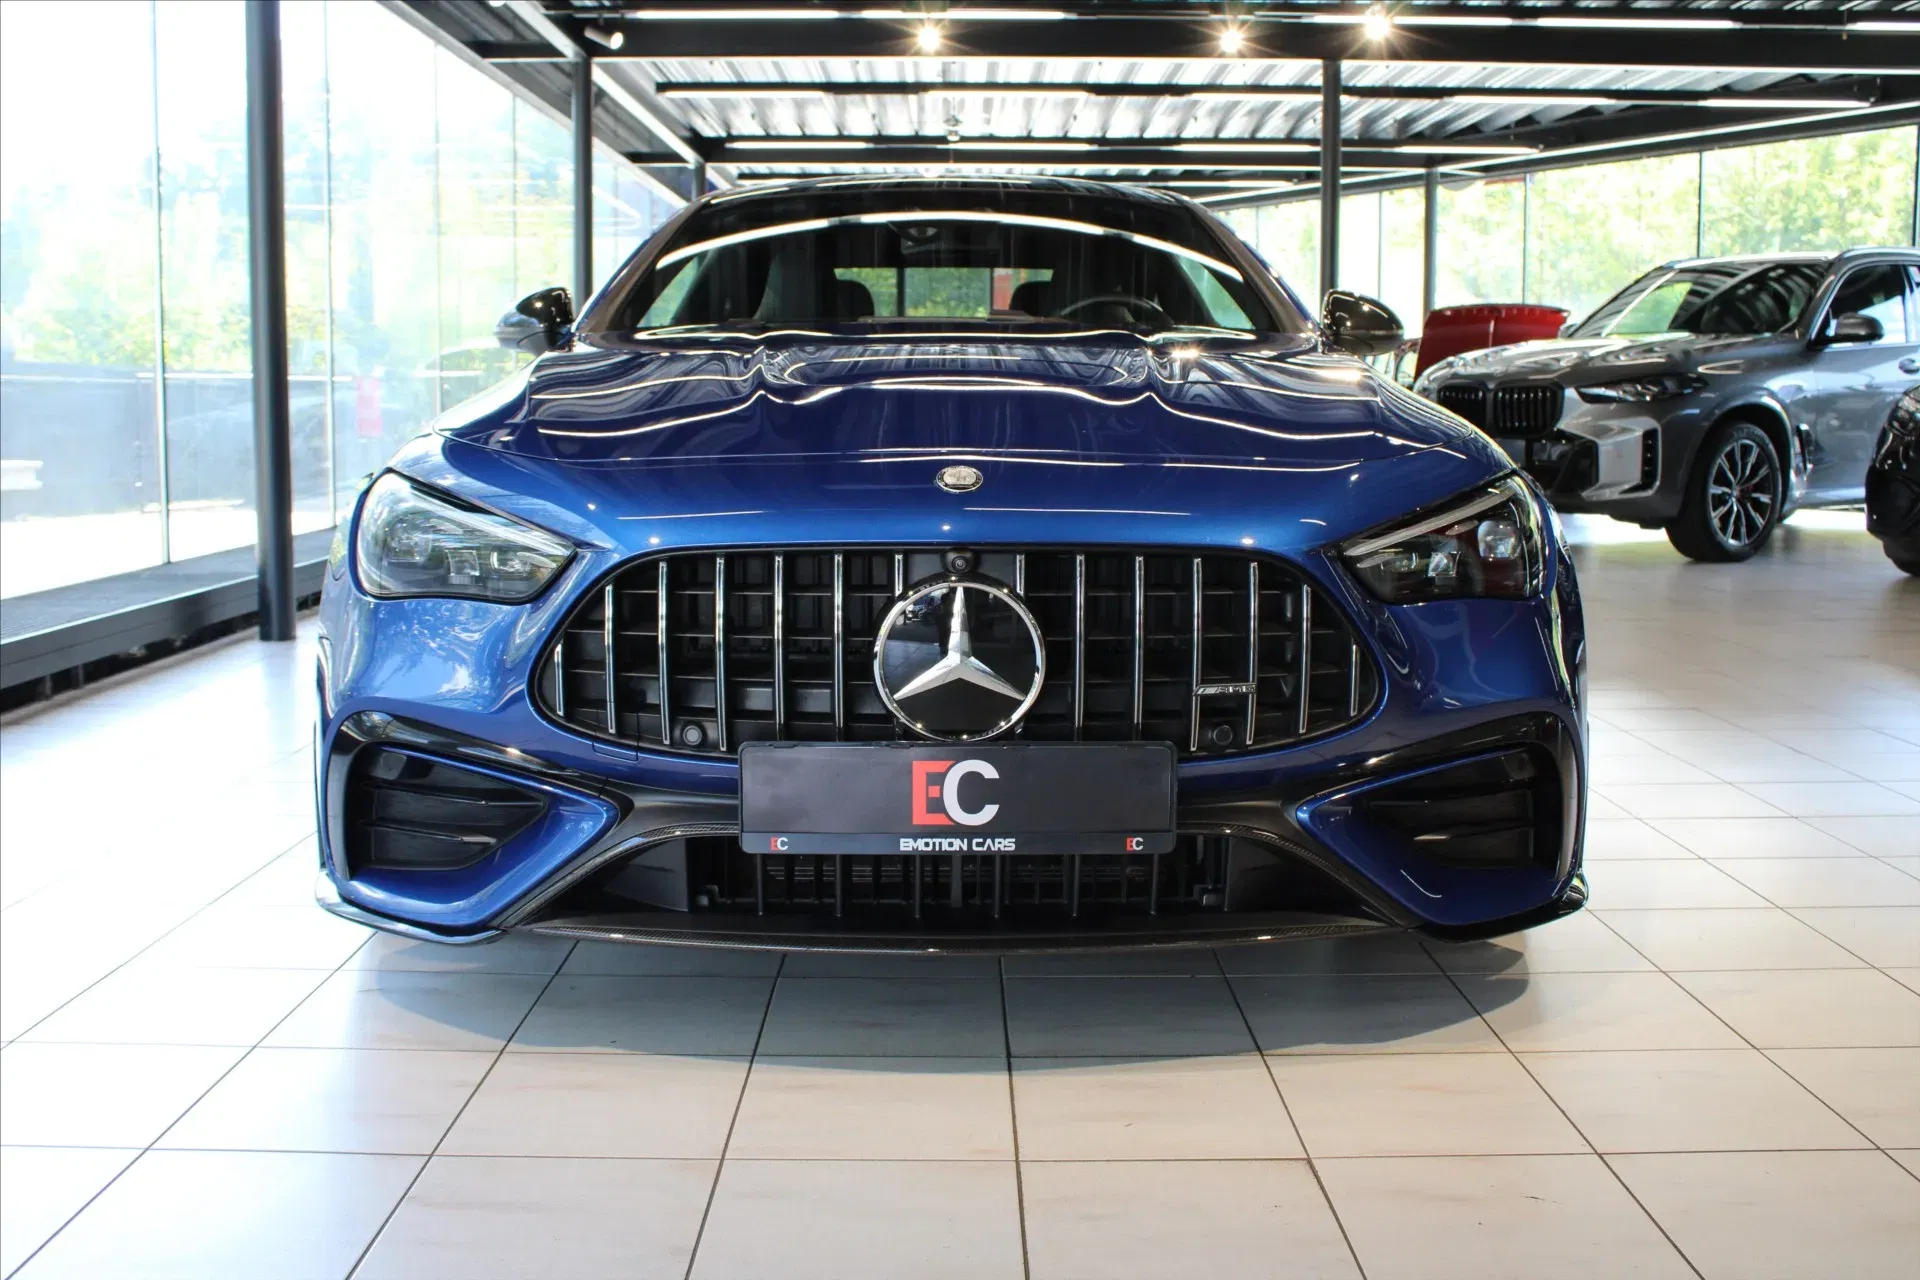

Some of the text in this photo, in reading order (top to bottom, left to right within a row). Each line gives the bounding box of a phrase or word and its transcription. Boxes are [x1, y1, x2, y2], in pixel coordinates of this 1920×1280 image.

[912, 759, 1000, 826] EC
[770, 837, 789, 851] EC
[900, 838, 1016, 851] EMOTION CARS
[1126, 837, 1144, 851] EC
